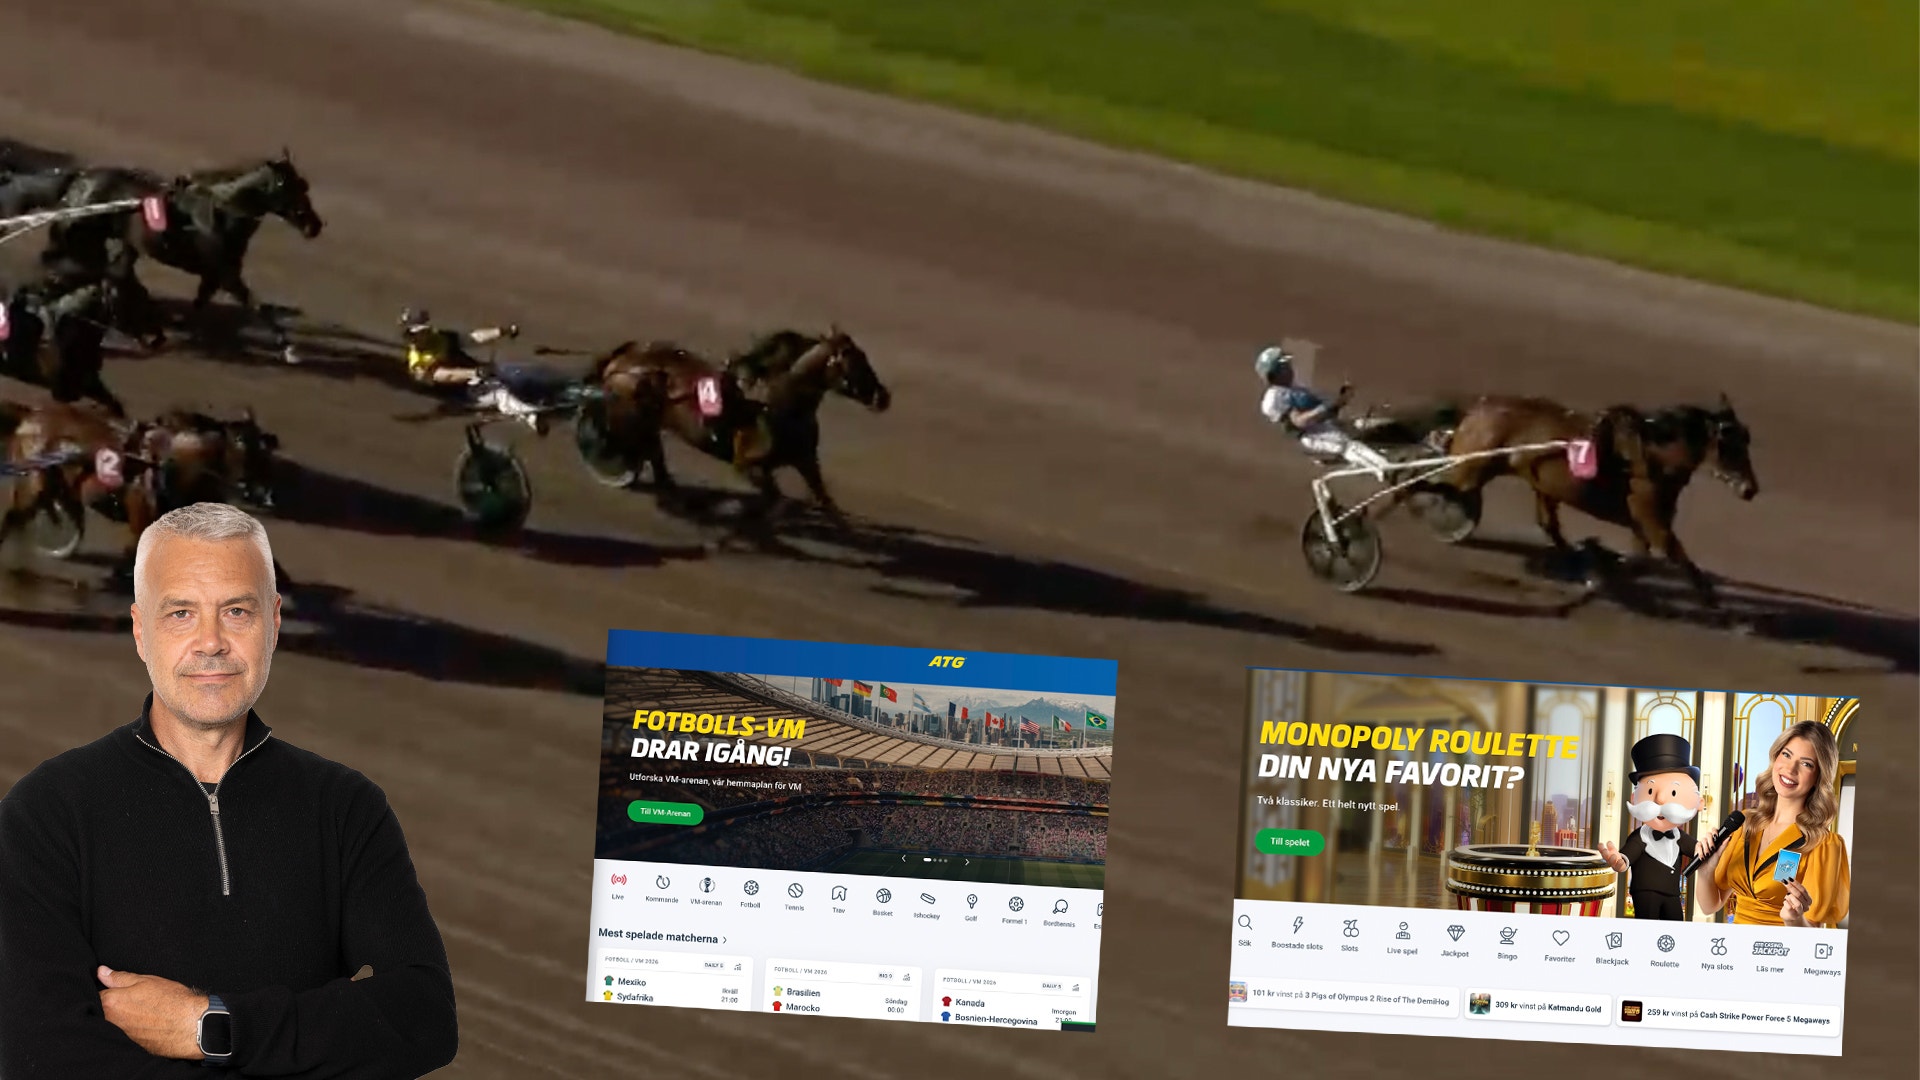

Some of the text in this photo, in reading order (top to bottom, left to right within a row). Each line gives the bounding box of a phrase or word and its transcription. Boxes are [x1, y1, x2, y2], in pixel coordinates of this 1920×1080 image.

[702, 379, 718, 404] 4
[102, 449, 119, 475] 2
[1573, 441, 1590, 464] 7
